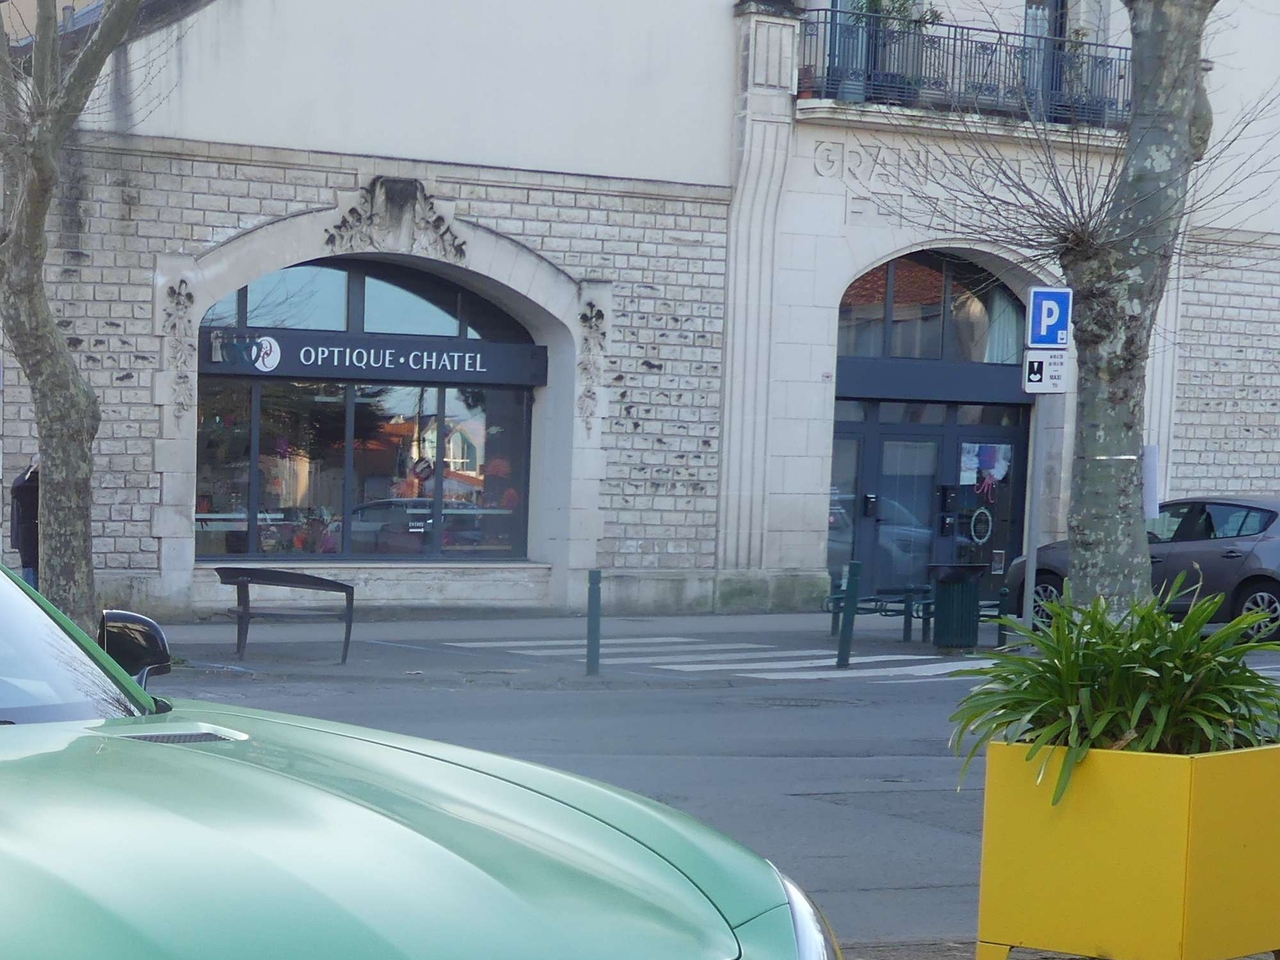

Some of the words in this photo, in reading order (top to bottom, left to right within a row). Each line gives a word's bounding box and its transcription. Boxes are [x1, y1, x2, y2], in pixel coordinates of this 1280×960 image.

[1041, 300, 1060, 335] P
[299, 346, 395, 369] OPTIQUE
[408, 351, 487, 372] CHATEL
